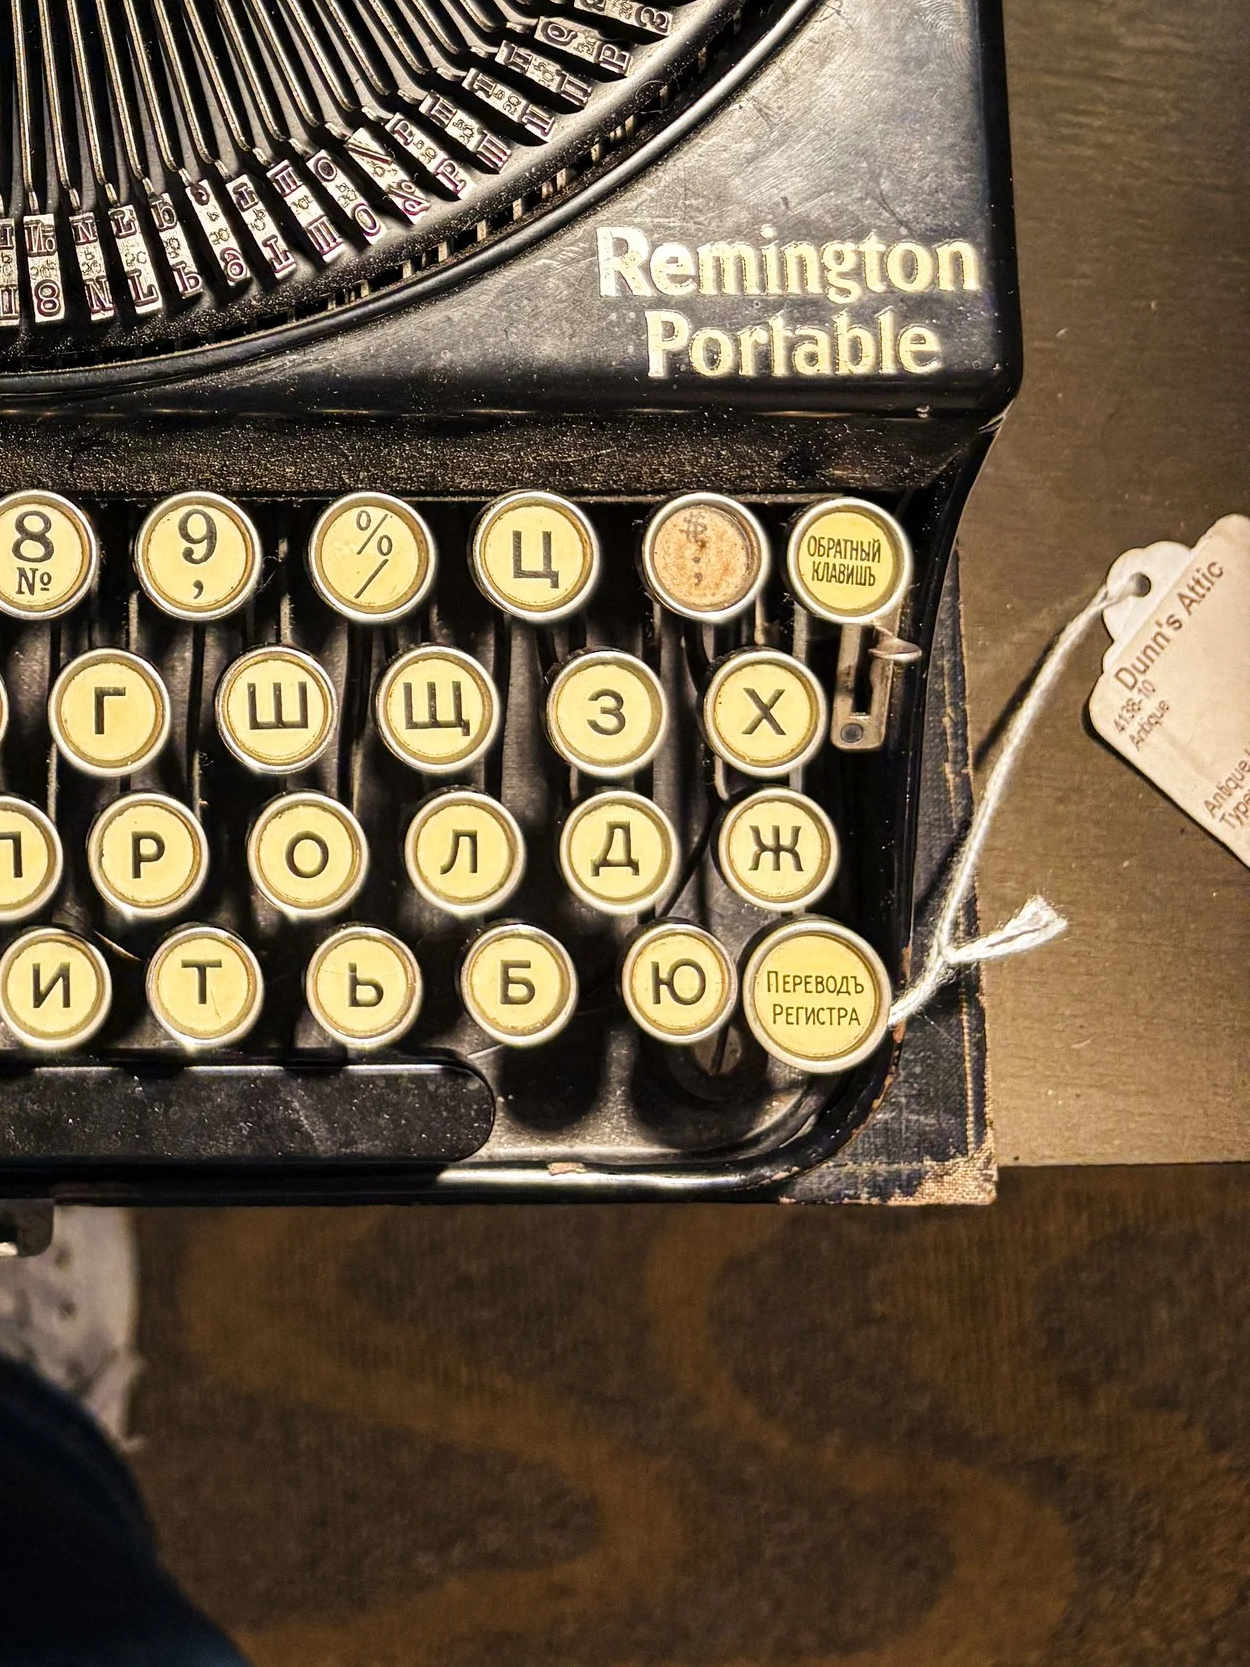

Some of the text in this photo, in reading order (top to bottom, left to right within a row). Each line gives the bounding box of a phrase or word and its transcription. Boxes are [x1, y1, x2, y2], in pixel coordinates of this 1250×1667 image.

[596, 224, 981, 304] Remington
[645, 305, 943, 378] Portable
[12, 511, 52, 563] 8
[178, 509, 218, 565] 9
[513, 530, 559, 589] Ц
[807, 535, 881, 563] ОБРАТНЫЙ
[811, 562, 876, 588] КЛАВИШЪ
[1114, 560, 1224, 692] Dunn's Attic
[95, 687, 126, 734] Г
[247, 681, 309, 731] Ш
[403, 680, 470, 736] Щ
[587, 689, 626, 735] З
[440, 830, 477, 875] Л
[591, 820, 640, 877] Д
[749, 826, 804, 871] Ж
[33, 963, 70, 1008] И
[349, 964, 383, 1007] Ь
[500, 960, 535, 1005] Б
[652, 959, 706, 1005] Ю
[772, 1004, 861, 1026] РЕГИСТРА
